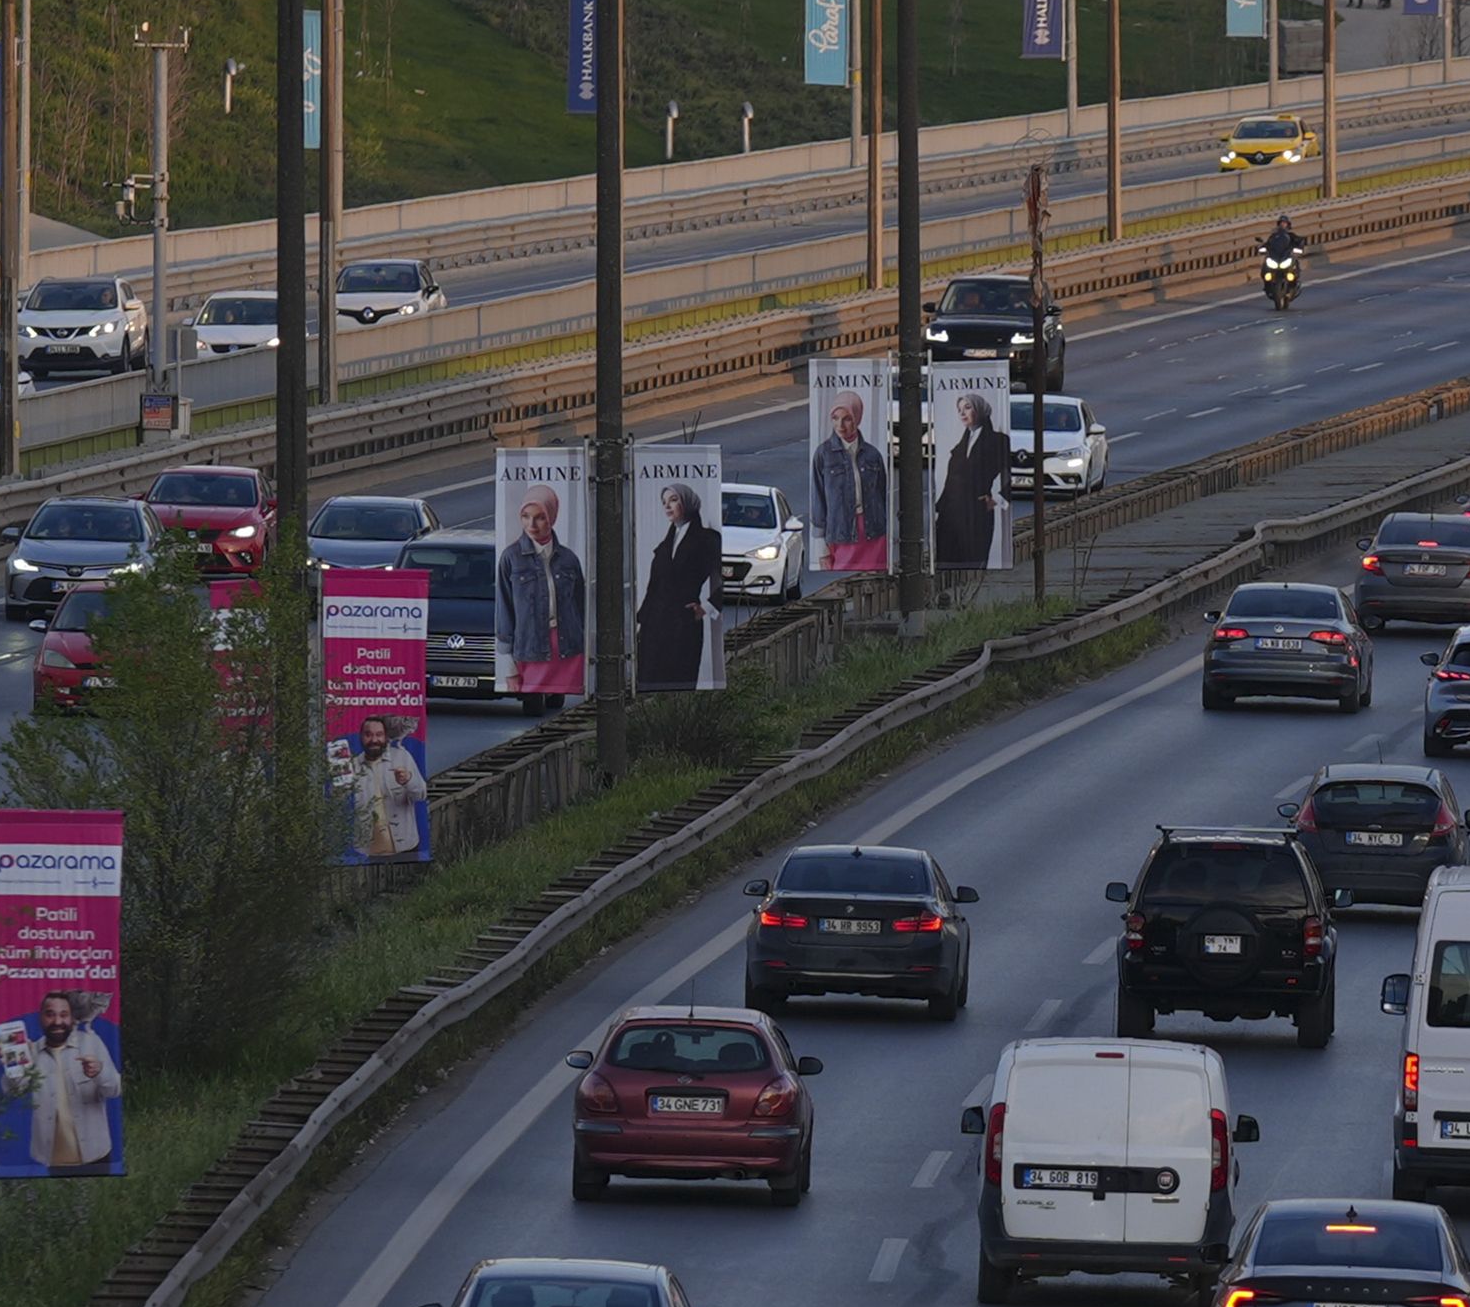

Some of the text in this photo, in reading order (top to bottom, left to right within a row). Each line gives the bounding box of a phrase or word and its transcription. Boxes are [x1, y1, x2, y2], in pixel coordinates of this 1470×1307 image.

[582, 0, 595, 81] HALKBANK
[813, 374, 885, 388] ARMINE
[935, 375, 1008, 391] ARMINE
[501, 466, 581, 482] ARMINE
[639, 464, 718, 480] ARMINE
[326, 604, 423, 620] pazarama
[357, 647, 391, 659] Patili
[342, 662, 406, 675] dostunun
[325, 693, 423, 707] Pazarama'da!
[1353, 833, 1364, 843] 34
[35, 907, 78, 921] Patili
[826, 920, 837, 931] 34
[18, 926, 95, 941] dostunun
[658, 1096, 721, 1112] 34 GNE 731
[1447, 1122, 1460, 1134] 34
[1030, 1170, 1043, 1182] 34
[1076, 1172, 1097, 1184] 819
